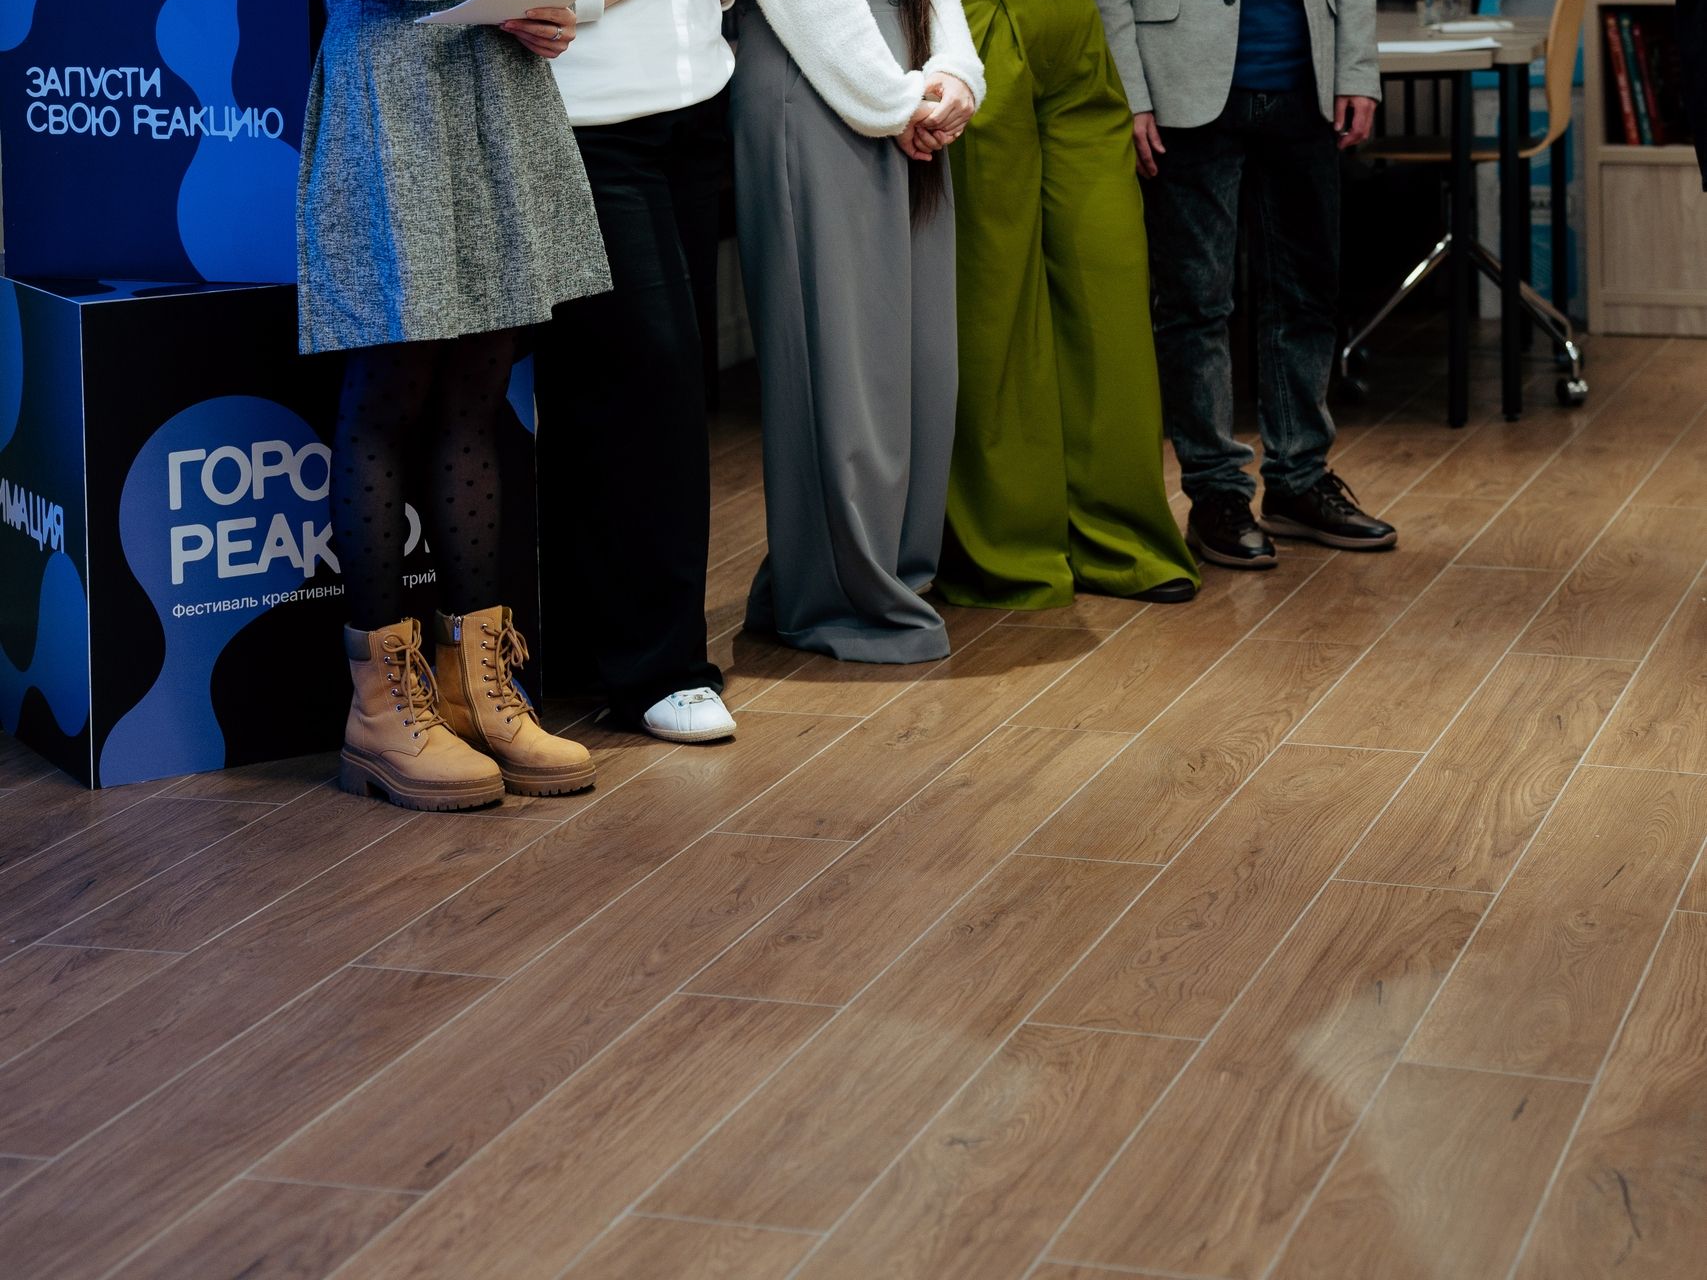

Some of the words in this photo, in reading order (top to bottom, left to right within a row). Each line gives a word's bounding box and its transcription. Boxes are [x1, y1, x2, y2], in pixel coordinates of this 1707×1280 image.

[26, 66, 161, 100] ЗАПУСТИ
[26, 101, 121, 137] СВОЮ
[133, 104, 284, 142] РЕАКЦИЮ
[168, 440, 332, 511] ГОРО
[172, 593, 259, 618] Фестиваль
[262, 583, 345, 607] креативны
